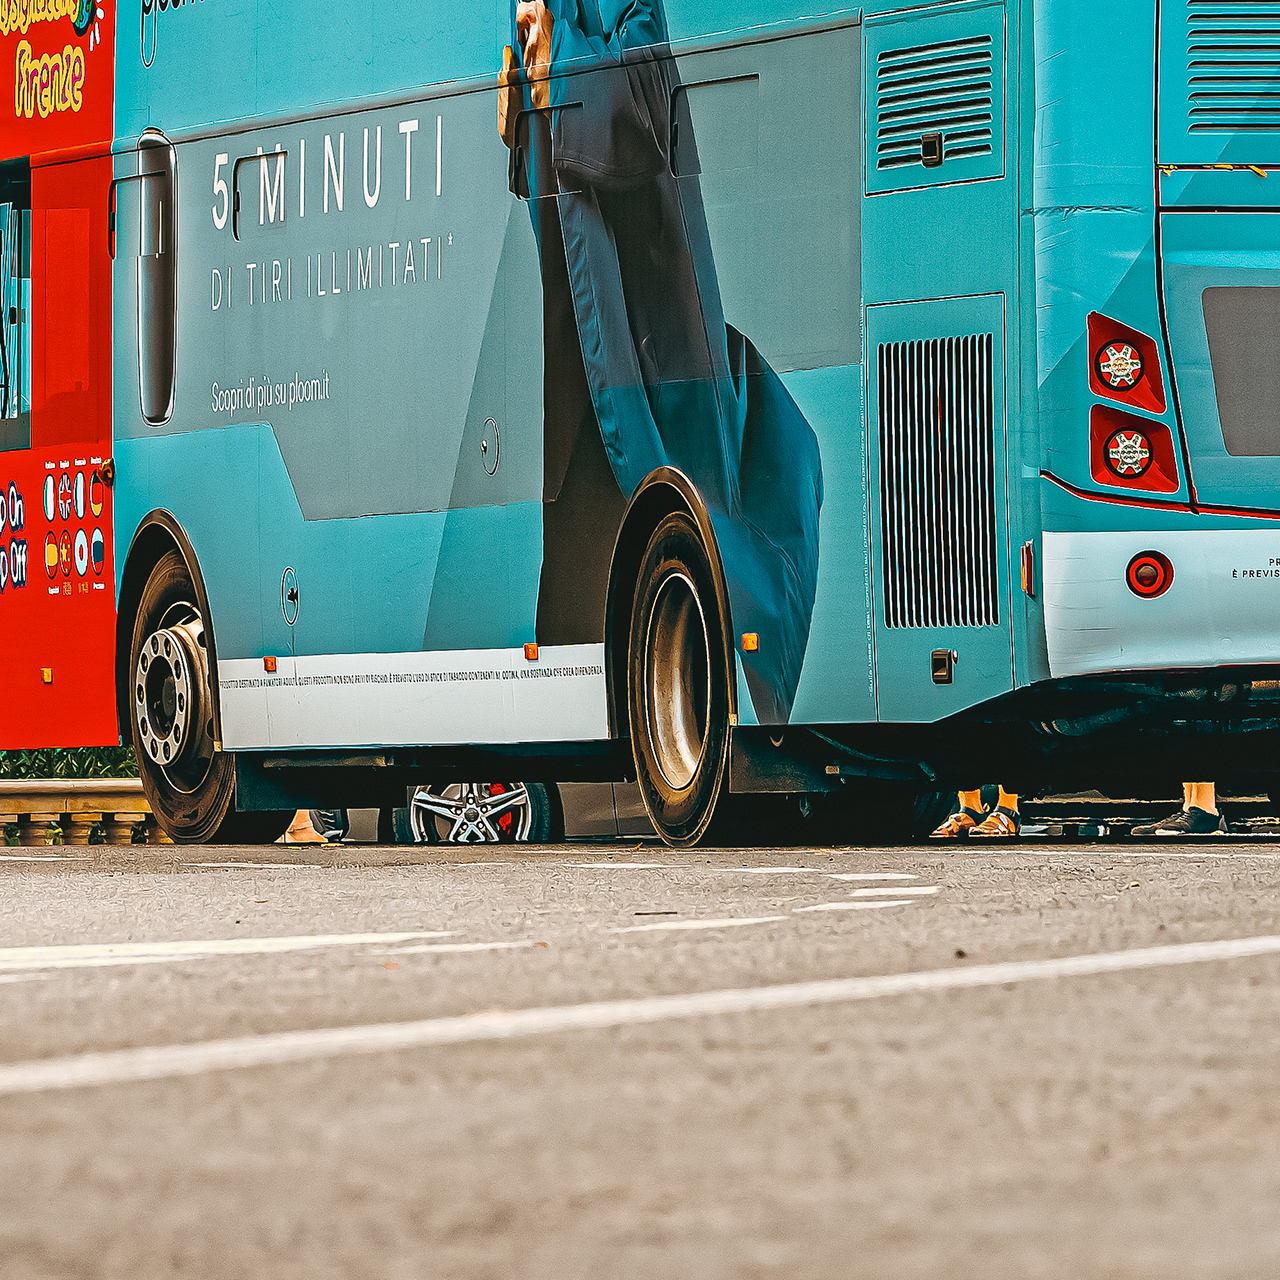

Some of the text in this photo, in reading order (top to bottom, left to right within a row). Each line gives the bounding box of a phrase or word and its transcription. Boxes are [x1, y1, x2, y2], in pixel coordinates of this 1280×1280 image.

[211, 116, 443, 231] 5 MINUTI
[211, 267, 232, 312] DI
[246, 258, 293, 307] TIRI
[211, 369, 330, 417] Scopri di più su ploom.it
[8, 484, 25, 528] On
[10, 540, 27, 583] Off
[1232, 566, 1238, 578] È
